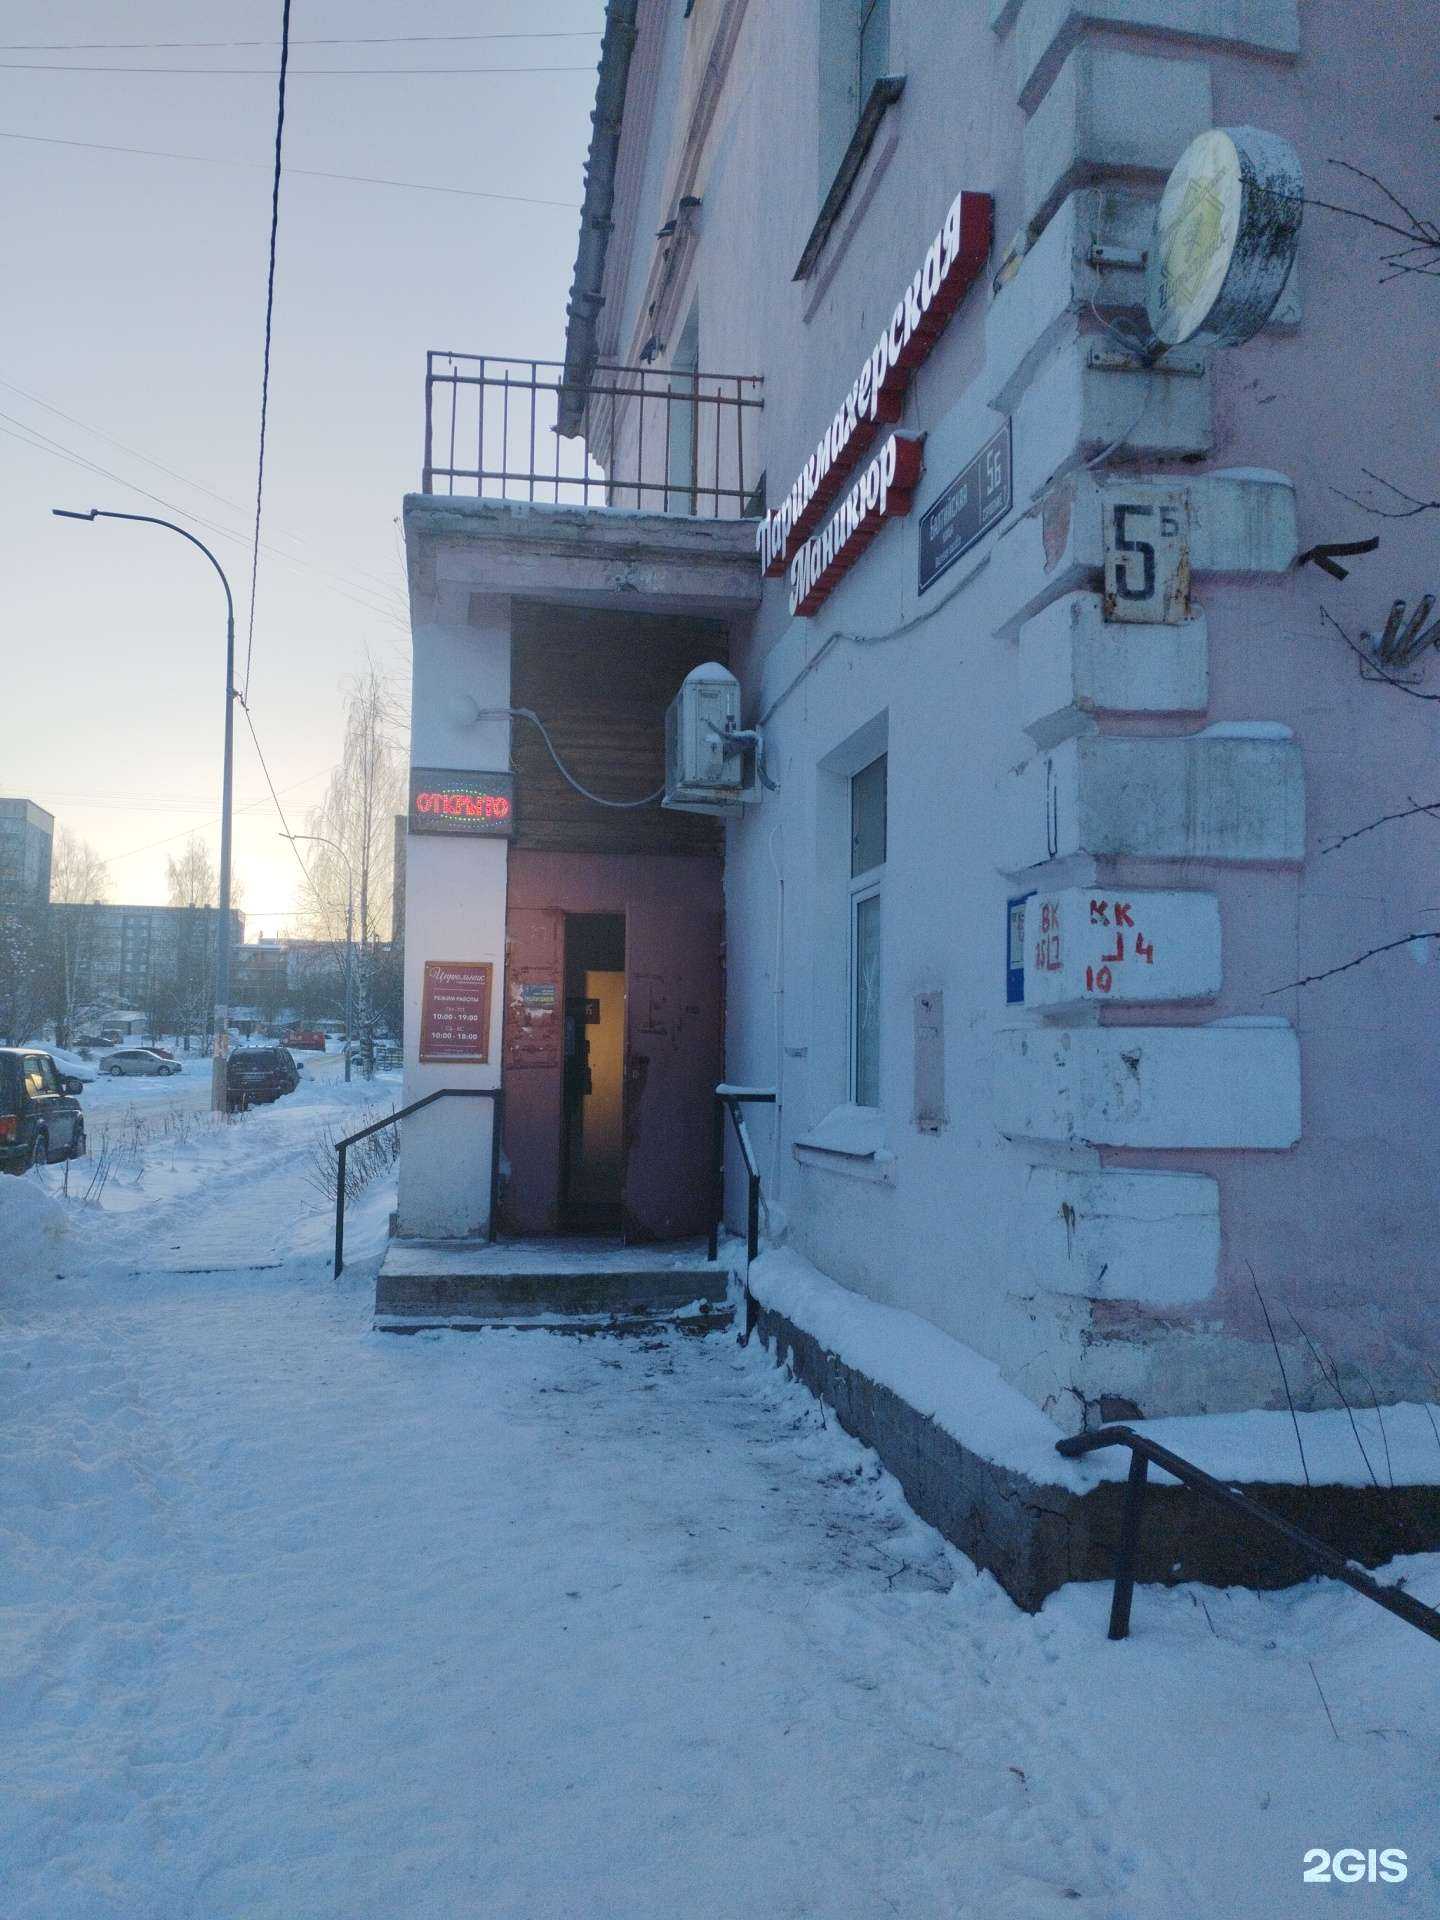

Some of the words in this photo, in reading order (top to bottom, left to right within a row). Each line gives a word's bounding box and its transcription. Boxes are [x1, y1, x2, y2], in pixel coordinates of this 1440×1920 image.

[755, 190, 962, 577] Парикмахерская
[788, 433, 897, 617] Маникюр
[415, 792, 510, 818] ОТКРЫТО
